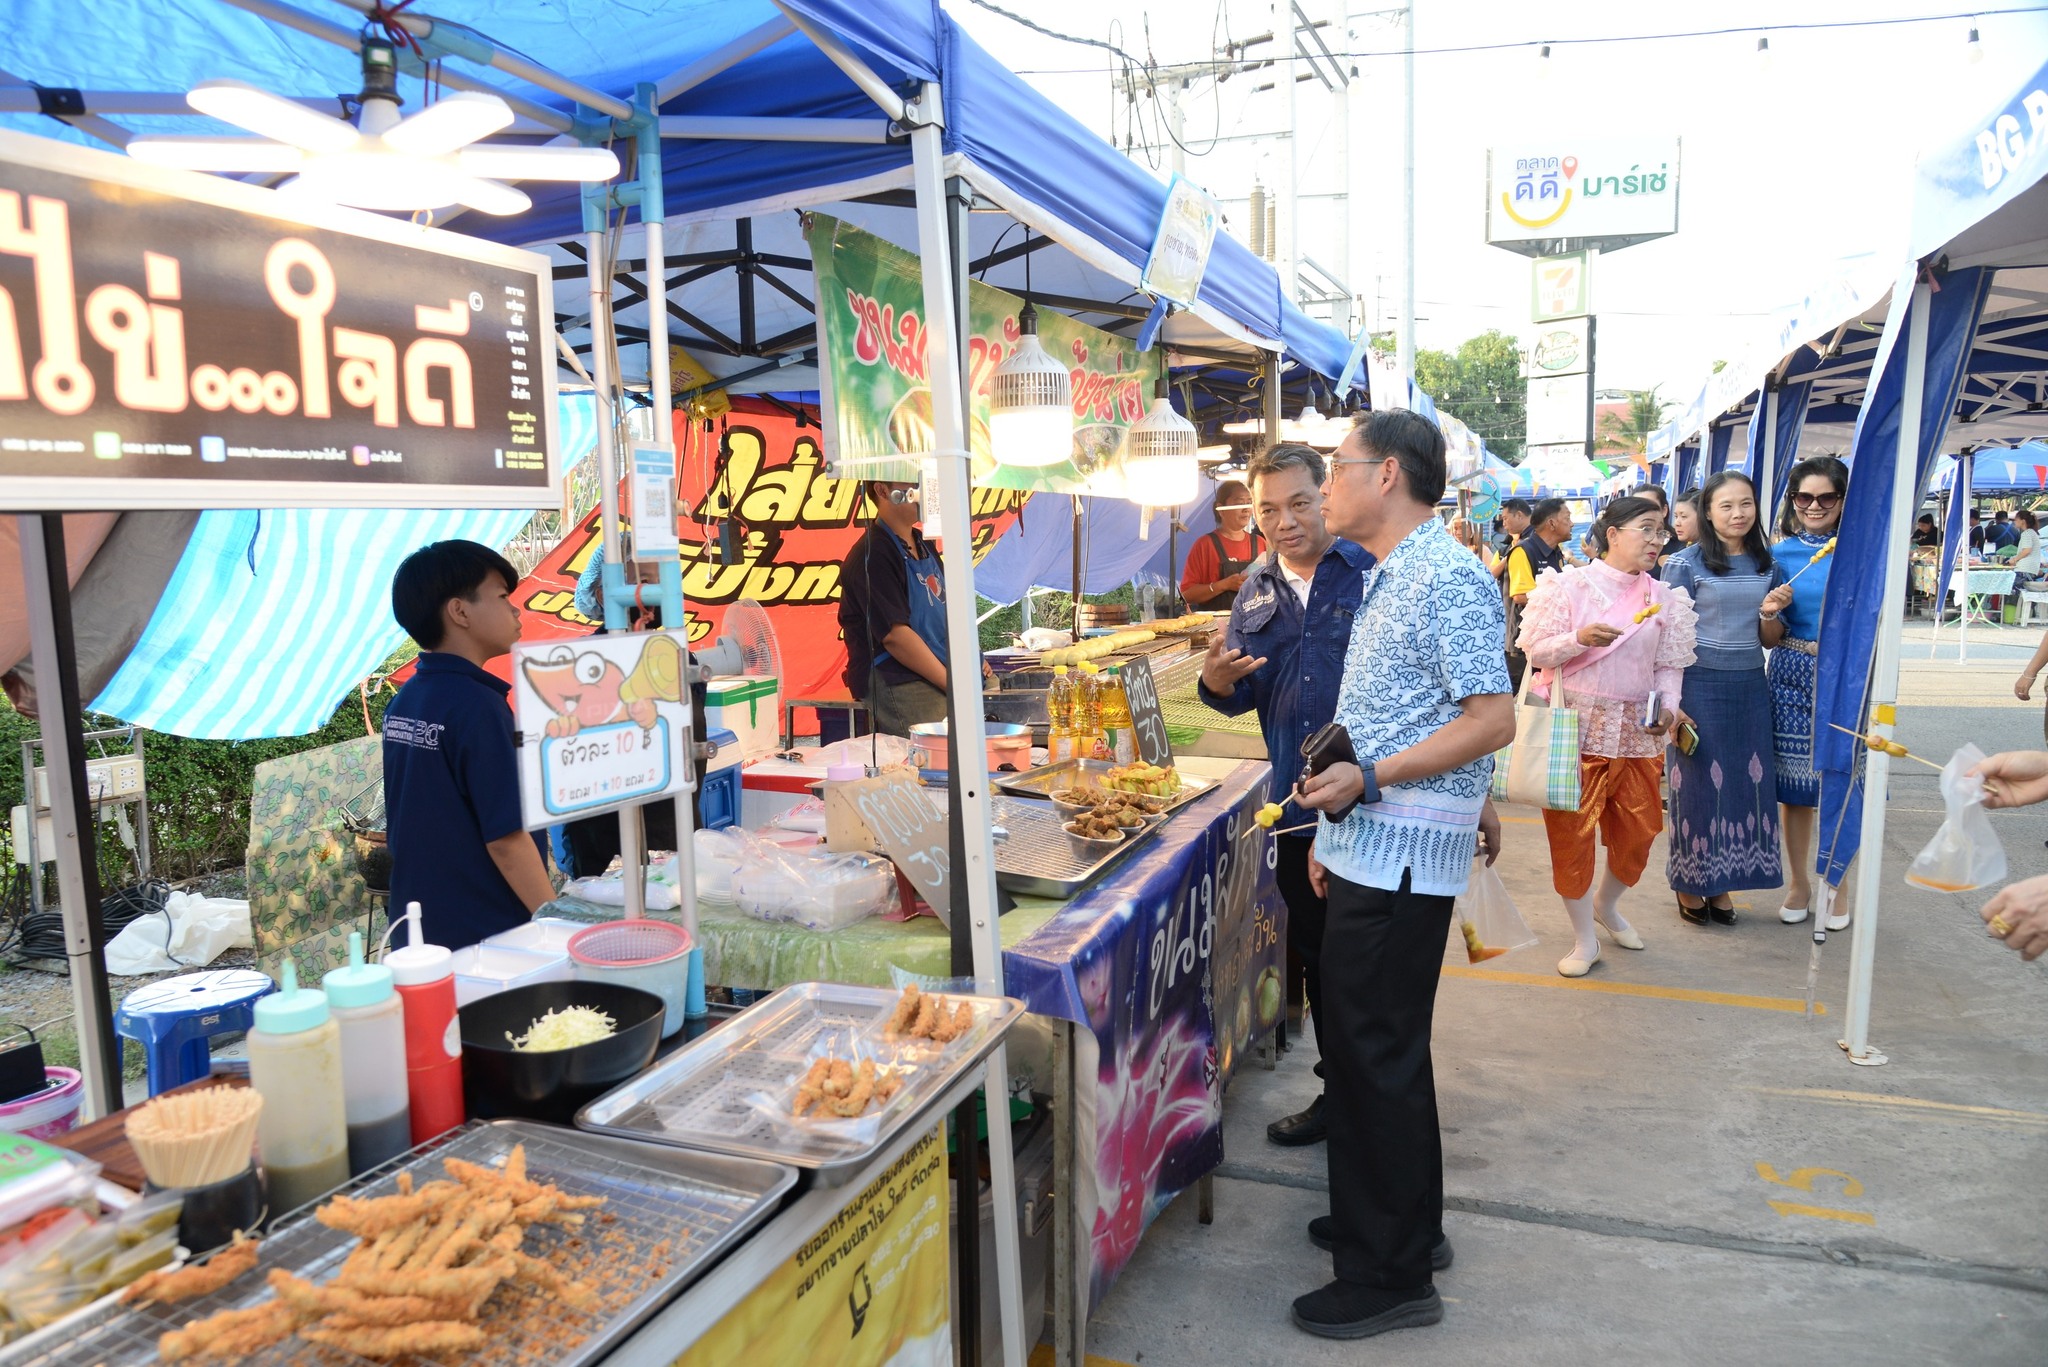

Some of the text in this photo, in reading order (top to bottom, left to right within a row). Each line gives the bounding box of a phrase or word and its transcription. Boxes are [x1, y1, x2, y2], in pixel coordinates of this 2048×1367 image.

[1516, 155, 1559, 170] ตลาด
[1583, 163, 1667, 197] มาร์เช่
[561, 737, 610, 766] ตัวละ
[616, 730, 634, 754] 10
[1137, 713, 1169, 765] 30
[558, 788, 566, 803] 5
[569, 786, 590, 801] แถม
[611, 775, 622, 790] 10
[625, 773, 645, 787] แถม
[648, 767, 656, 782] 2
[201, 1014, 220, 1026] est
